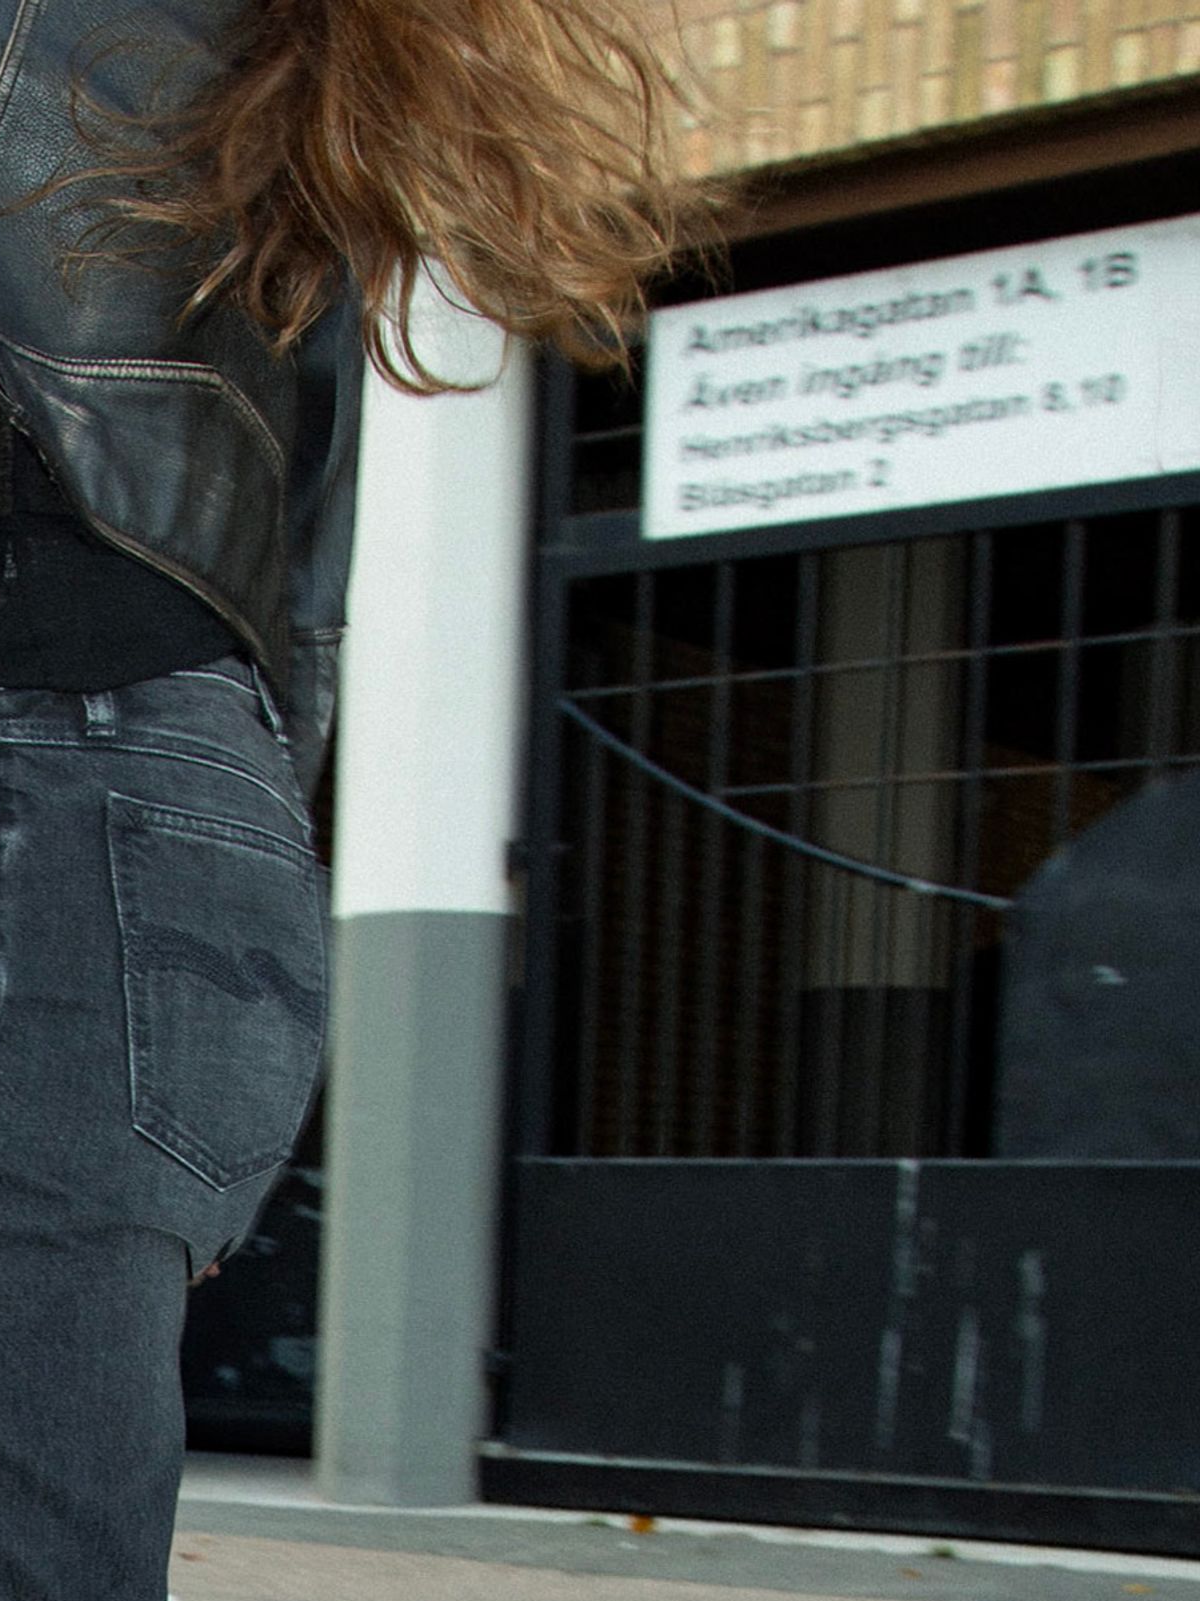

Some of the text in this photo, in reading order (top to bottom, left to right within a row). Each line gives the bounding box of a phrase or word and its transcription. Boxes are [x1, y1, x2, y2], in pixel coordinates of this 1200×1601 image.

[687, 287, 975, 352] Amerikagatan
[1079, 250, 1139, 292] 1B
[680, 396, 1031, 461] Henriksbergsgatan
[869, 457, 889, 487] 2
